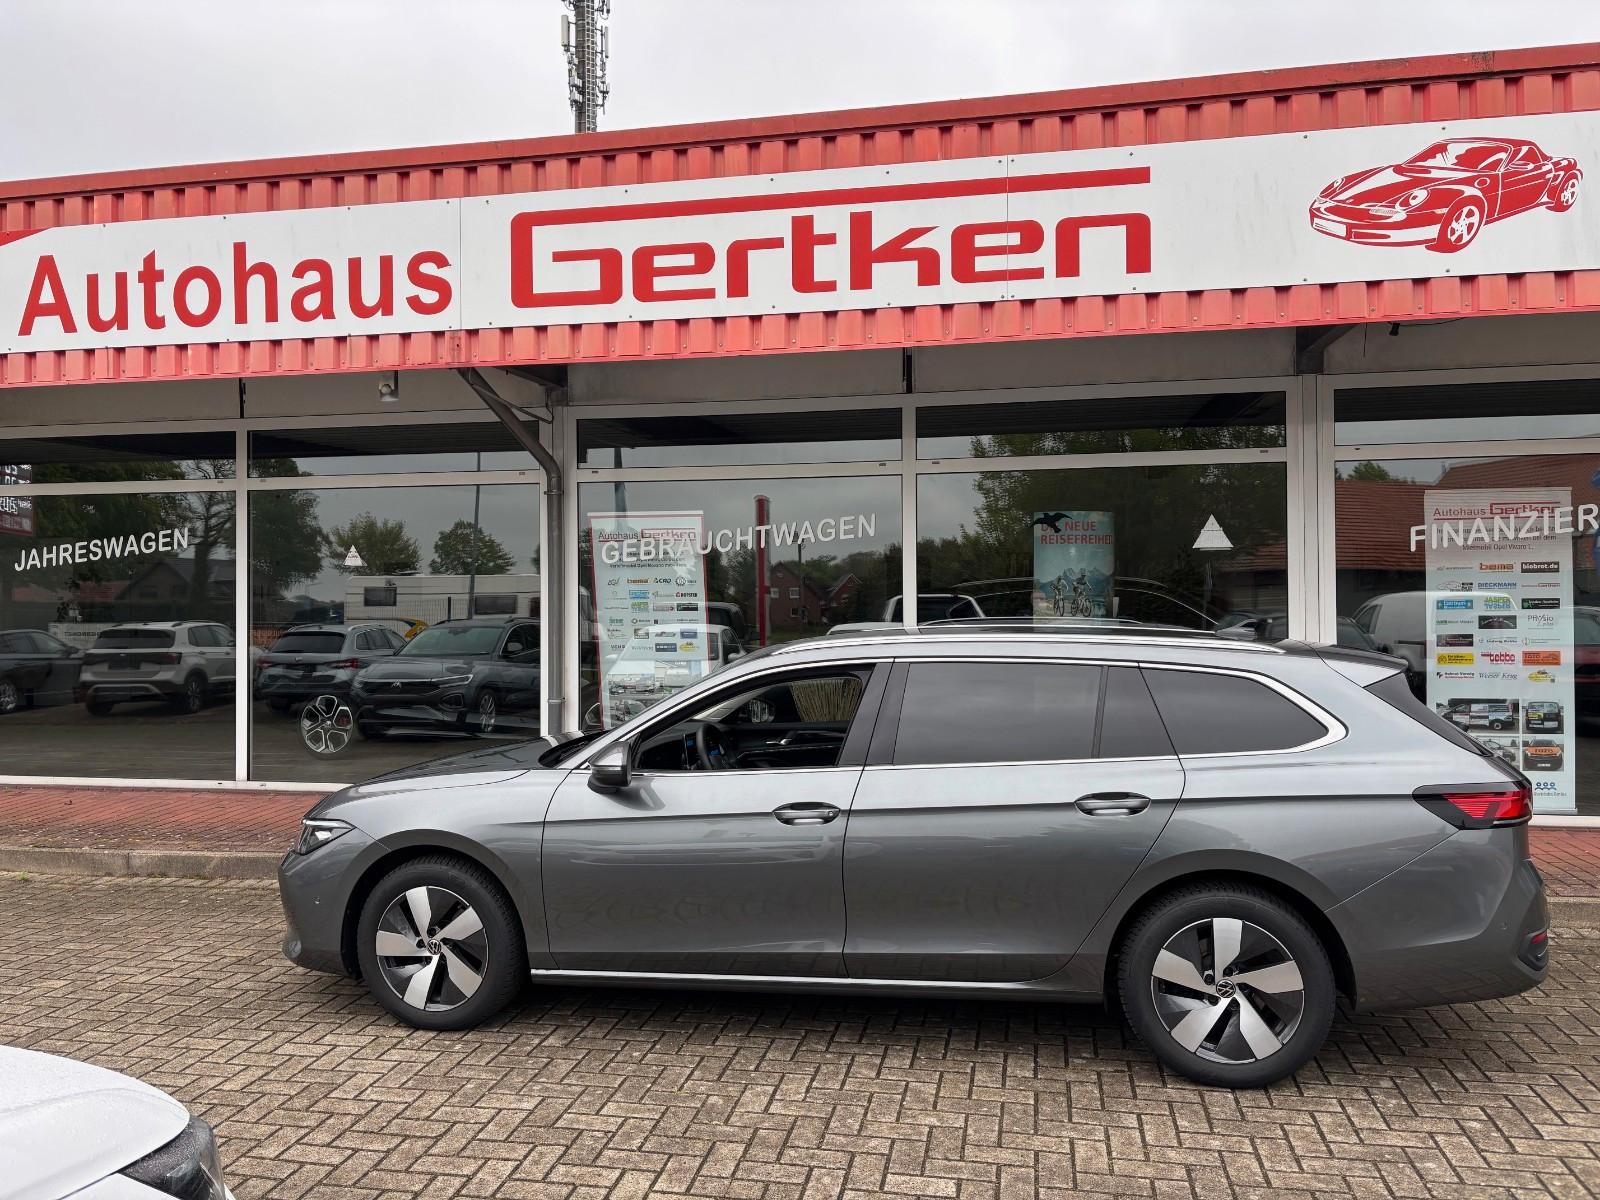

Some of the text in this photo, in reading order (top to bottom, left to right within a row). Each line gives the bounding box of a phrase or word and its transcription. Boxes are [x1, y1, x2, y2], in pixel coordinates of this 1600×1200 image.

[18, 166, 1151, 337] Autohaus Gertken
[1064, 521, 1097, 532] NEUE
[1410, 503, 1600, 553] FINANZIER
[1433, 507, 1486, 517] Autohaus
[14, 527, 189, 571] JAHRESWAGEN
[598, 531, 639, 540] Autohaus
[601, 513, 876, 564] GEBRAUCHTWAGEN
